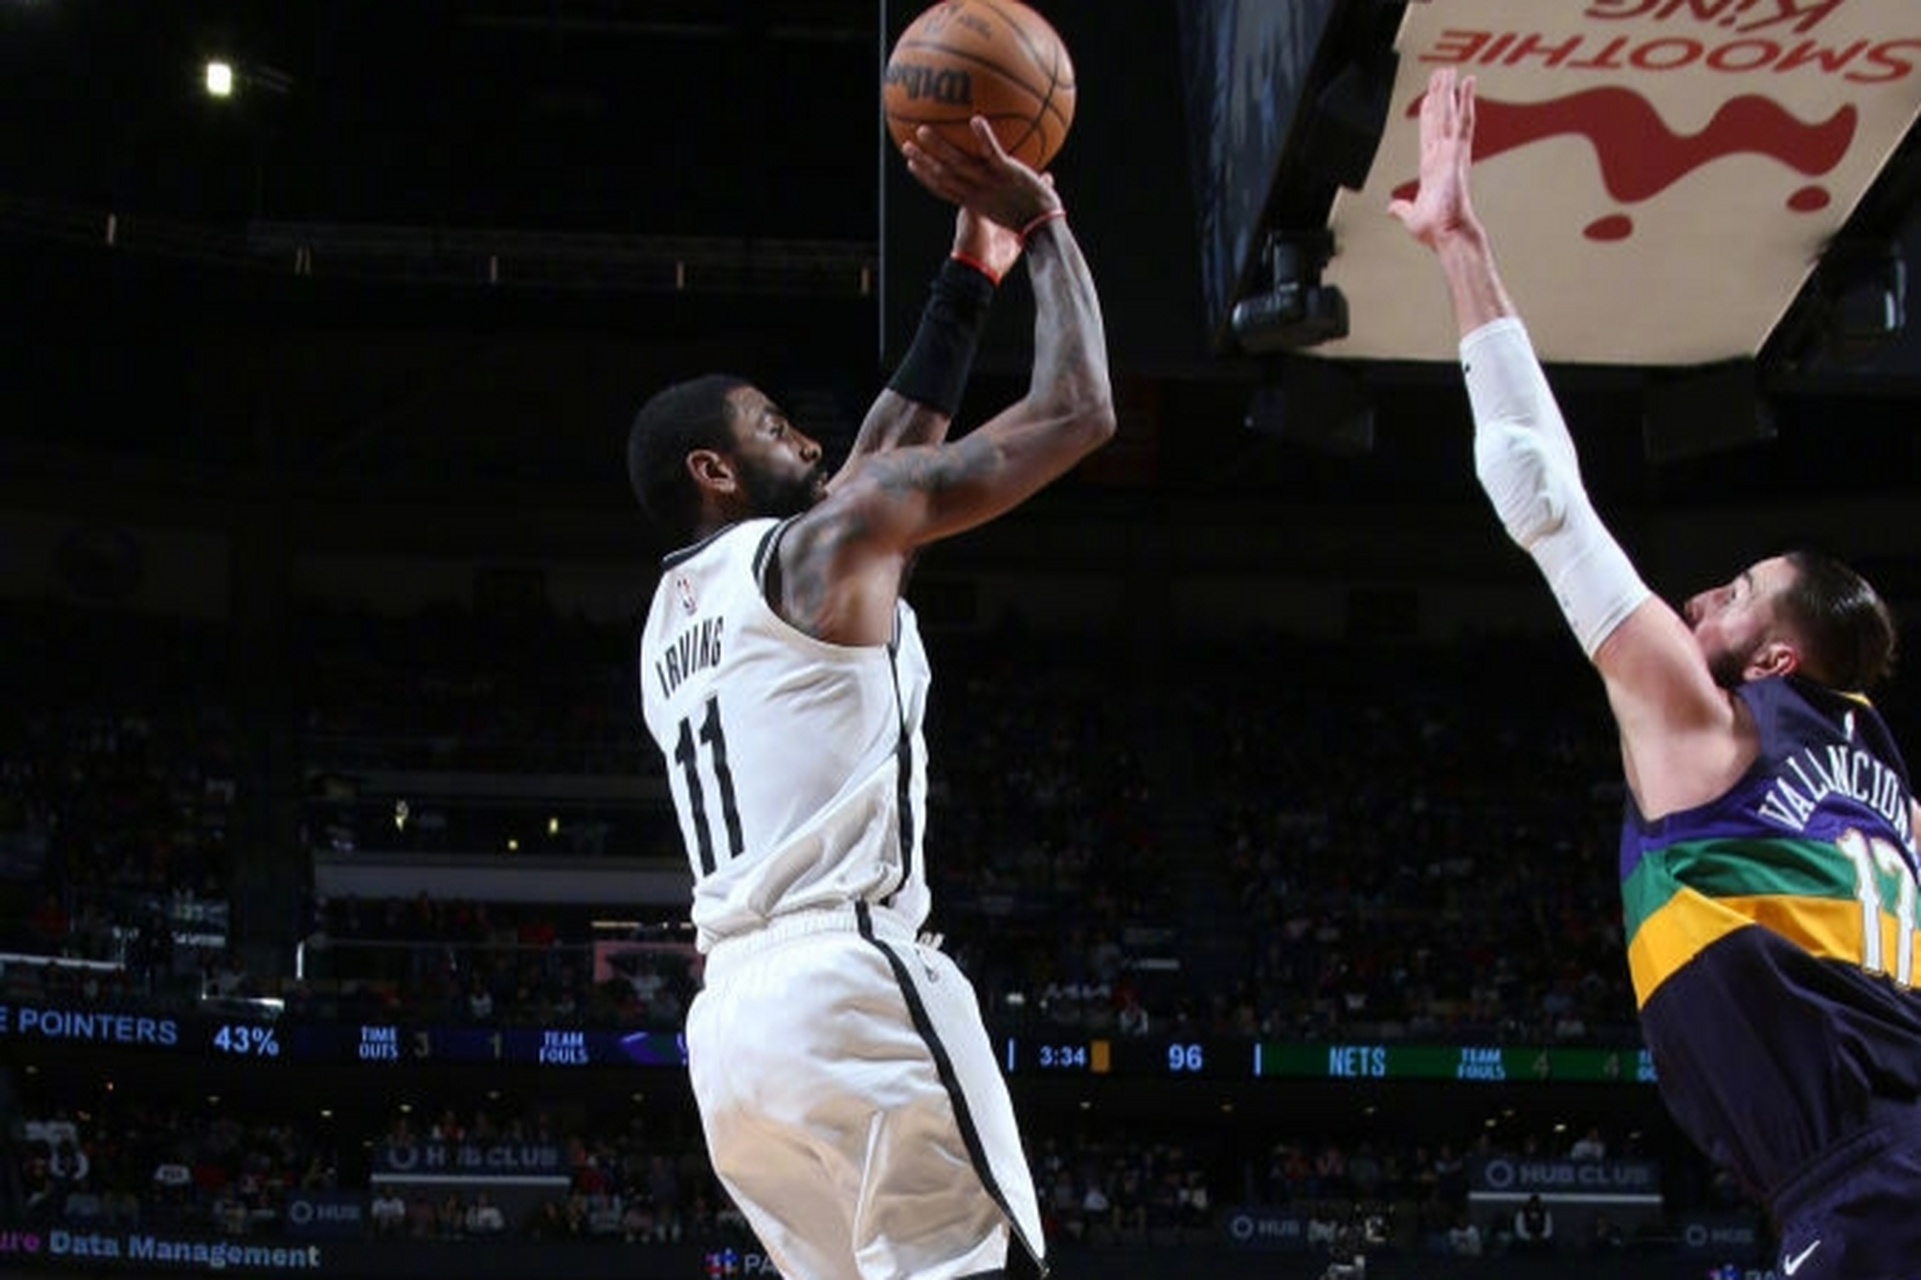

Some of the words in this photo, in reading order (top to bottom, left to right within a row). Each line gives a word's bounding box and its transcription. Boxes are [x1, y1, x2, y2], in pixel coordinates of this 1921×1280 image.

[1418, 29, 1921, 84] SMOOTHIE
[656, 616, 723, 699] IRVING
[675, 695, 744, 877] 11
[17, 1007, 179, 1047] POINTERS
[360, 1025, 398, 1042] TIME
[213, 1024, 280, 1057] 43%
[358, 1042, 399, 1059] OUTS
[543, 1031, 584, 1047] TEAM
[538, 1047, 589, 1064] FOULS
[1038, 1044, 1087, 1067] 3:34
[1168, 1044, 1203, 1072] 96
[1329, 1045, 1386, 1077] NETS
[1459, 1046, 1502, 1063] TEAM
[1456, 1063, 1506, 1081] FOULS
[426, 1145, 483, 1167] HB
[486, 1146, 559, 1168] CLUB
[1520, 1161, 1575, 1184] HUB
[1578, 1163, 1651, 1185] CLUB
[316, 1203, 361, 1221] HUB
[49, 1229, 120, 1257] Data
[128, 1234, 321, 1270] Management
